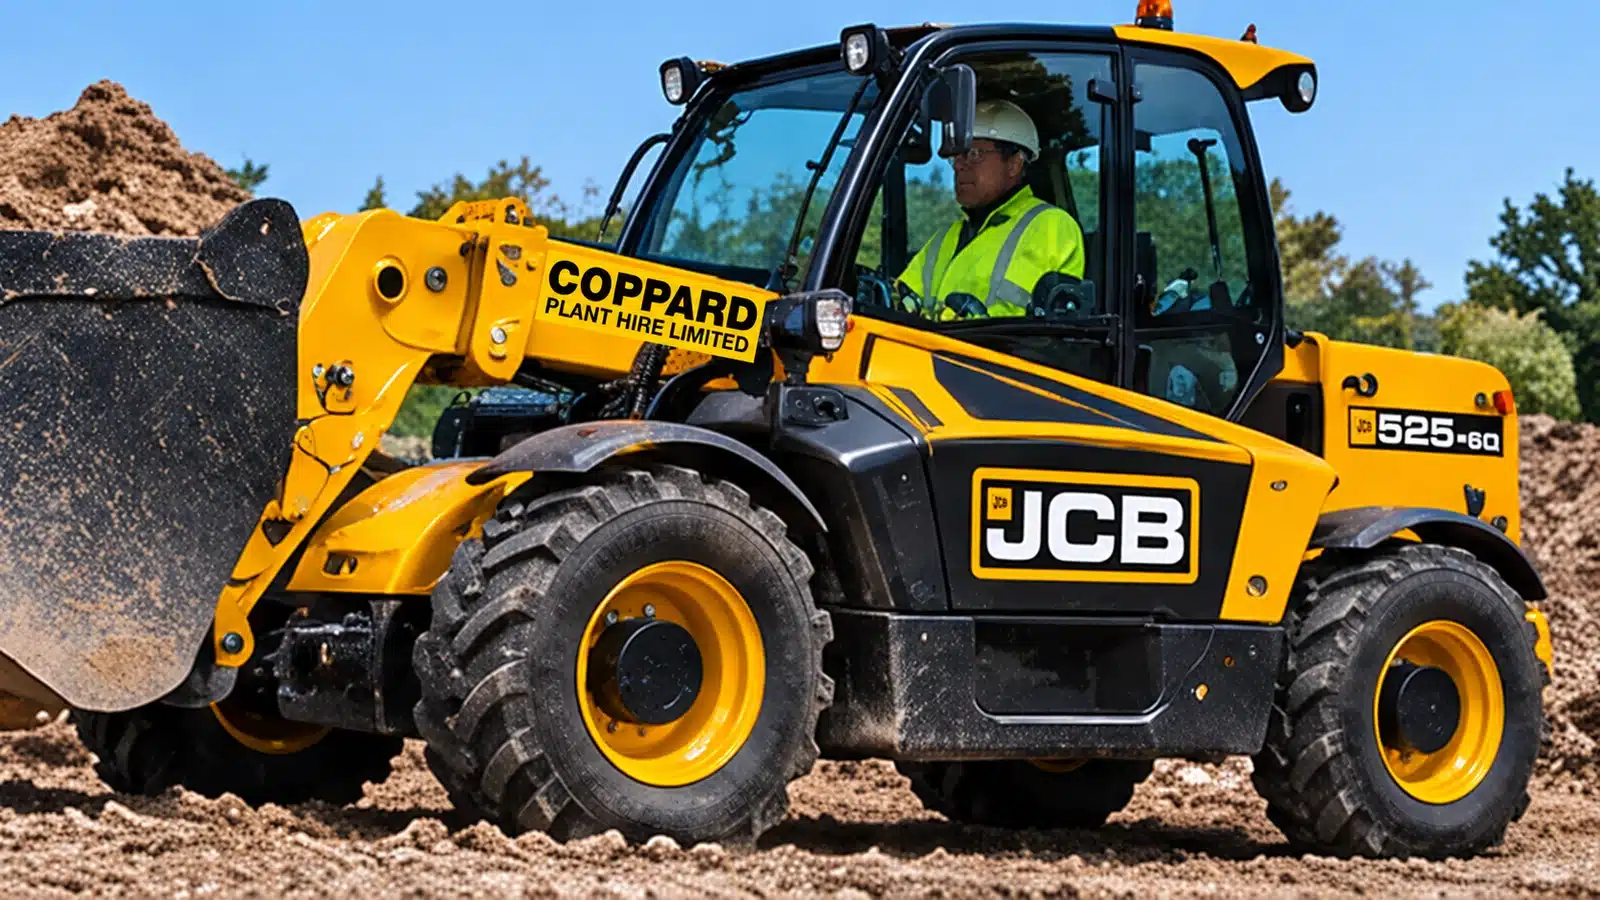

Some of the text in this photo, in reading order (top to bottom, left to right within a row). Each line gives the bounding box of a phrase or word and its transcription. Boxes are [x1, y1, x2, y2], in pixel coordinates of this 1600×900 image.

[545, 297, 749, 353] PLANT HIRE LIMITED
[548, 260, 758, 331] COPPARD
[986, 490, 1185, 565] JCB
